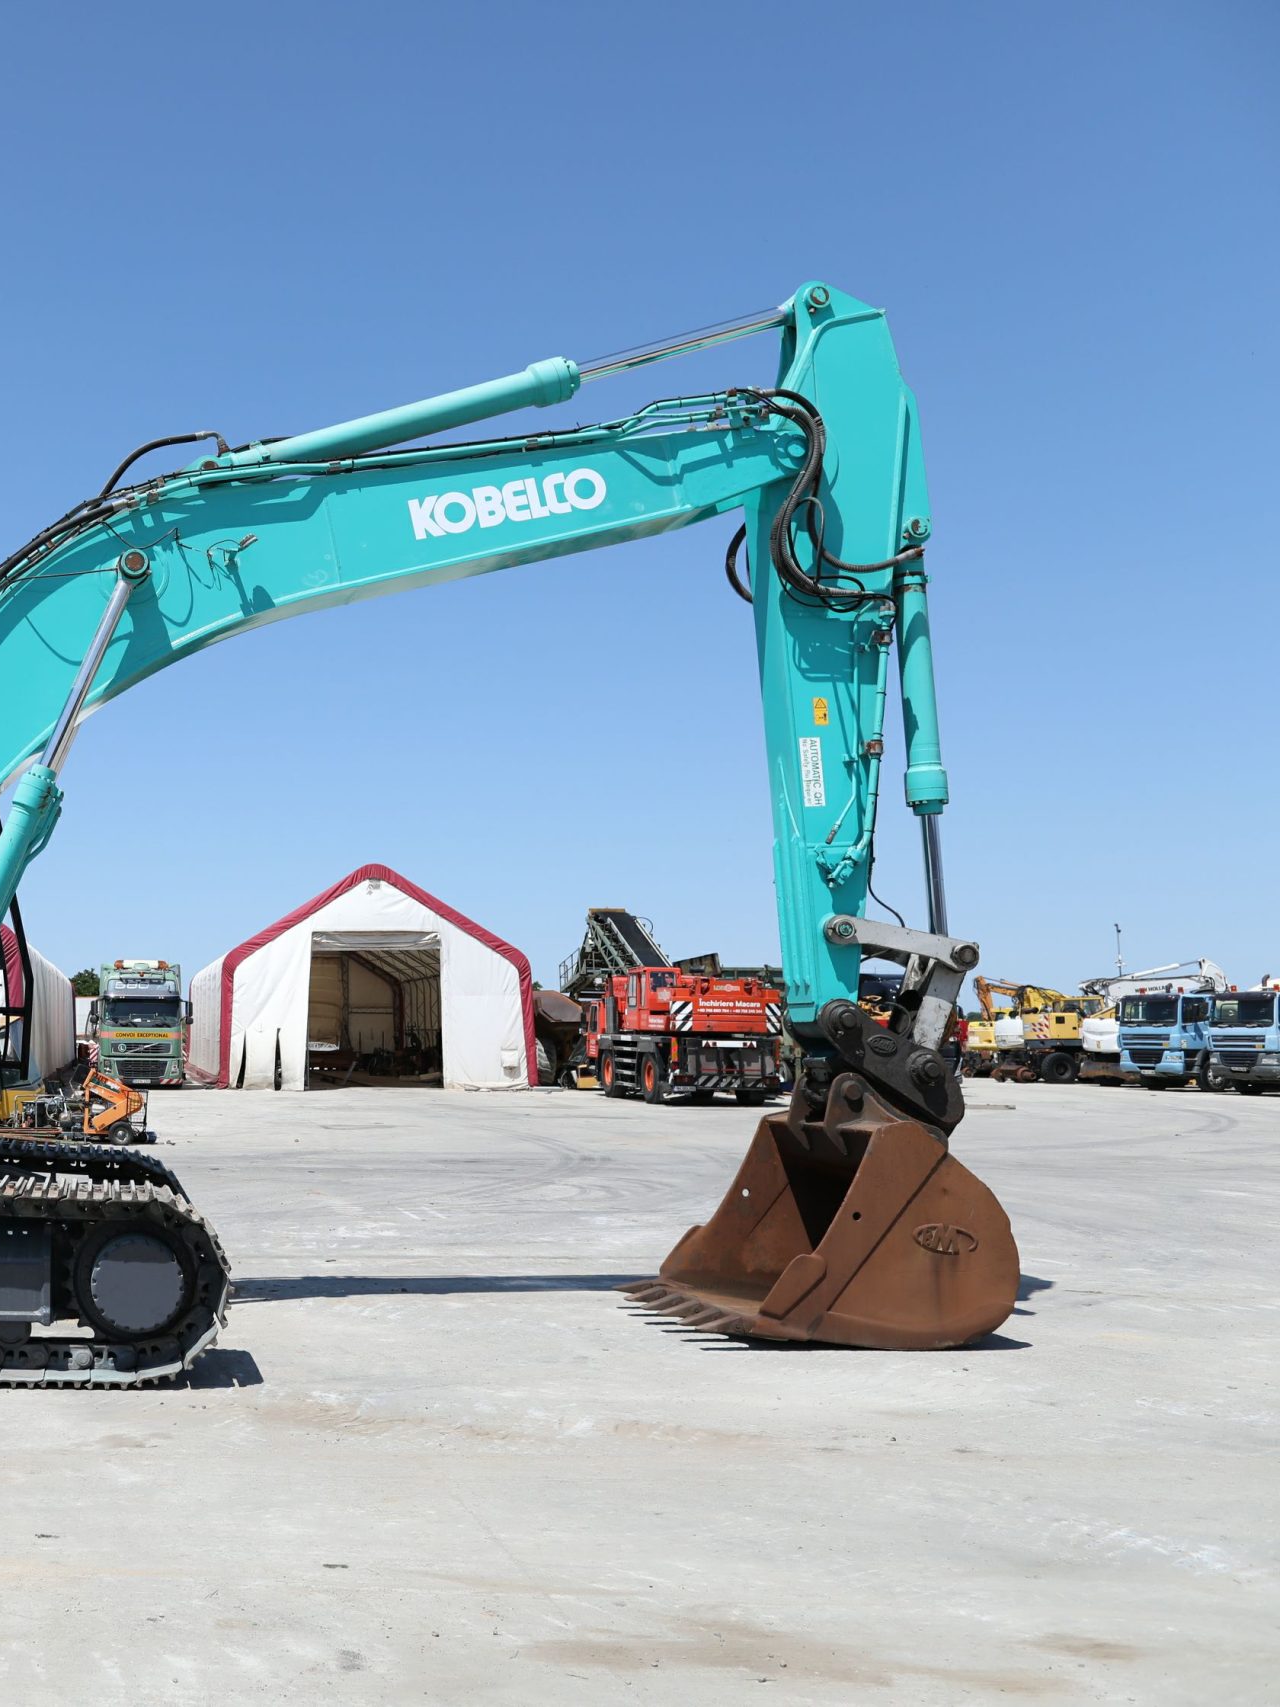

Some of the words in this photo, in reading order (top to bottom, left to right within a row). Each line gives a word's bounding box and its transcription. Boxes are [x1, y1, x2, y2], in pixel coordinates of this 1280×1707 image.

[408, 468, 606, 540] KOBELCO
[810, 739, 821, 789] AUTOMATIC
[814, 791, 822, 805] QH
[735, 1000, 761, 1008] Macara
